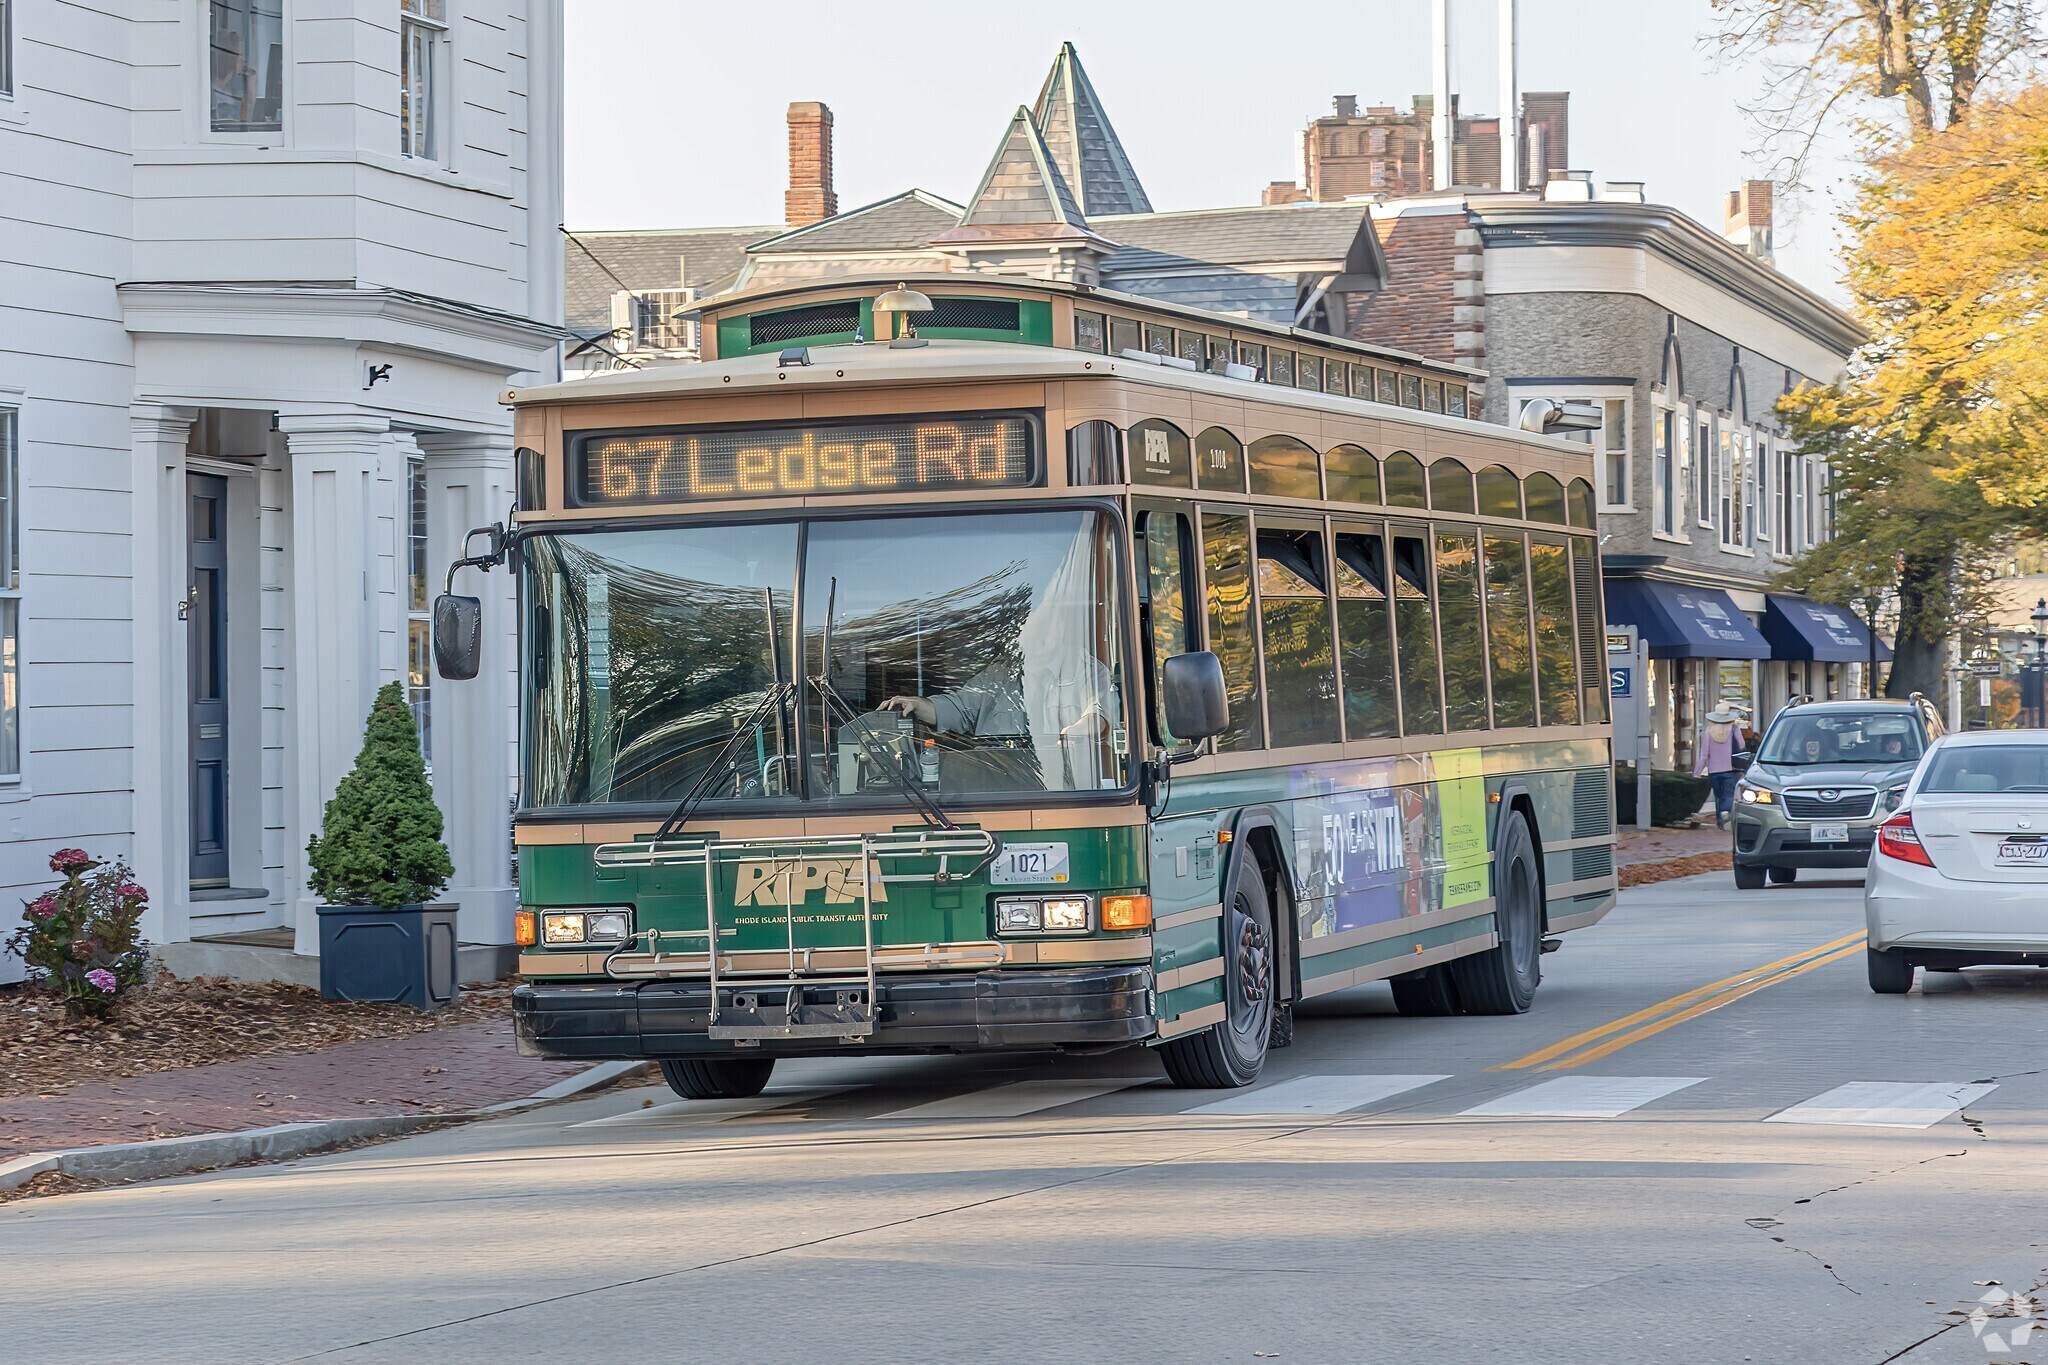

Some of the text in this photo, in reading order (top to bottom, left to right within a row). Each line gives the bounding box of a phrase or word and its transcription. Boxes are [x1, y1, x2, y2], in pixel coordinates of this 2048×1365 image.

[602, 423, 1007, 497] 67 Ledge Rd
[1010, 853, 1047, 873] 1021
[761, 916, 787, 924] ISLAND
[816, 914, 845, 922] TRANSIT
[847, 913, 889, 922] AUTHRITY
